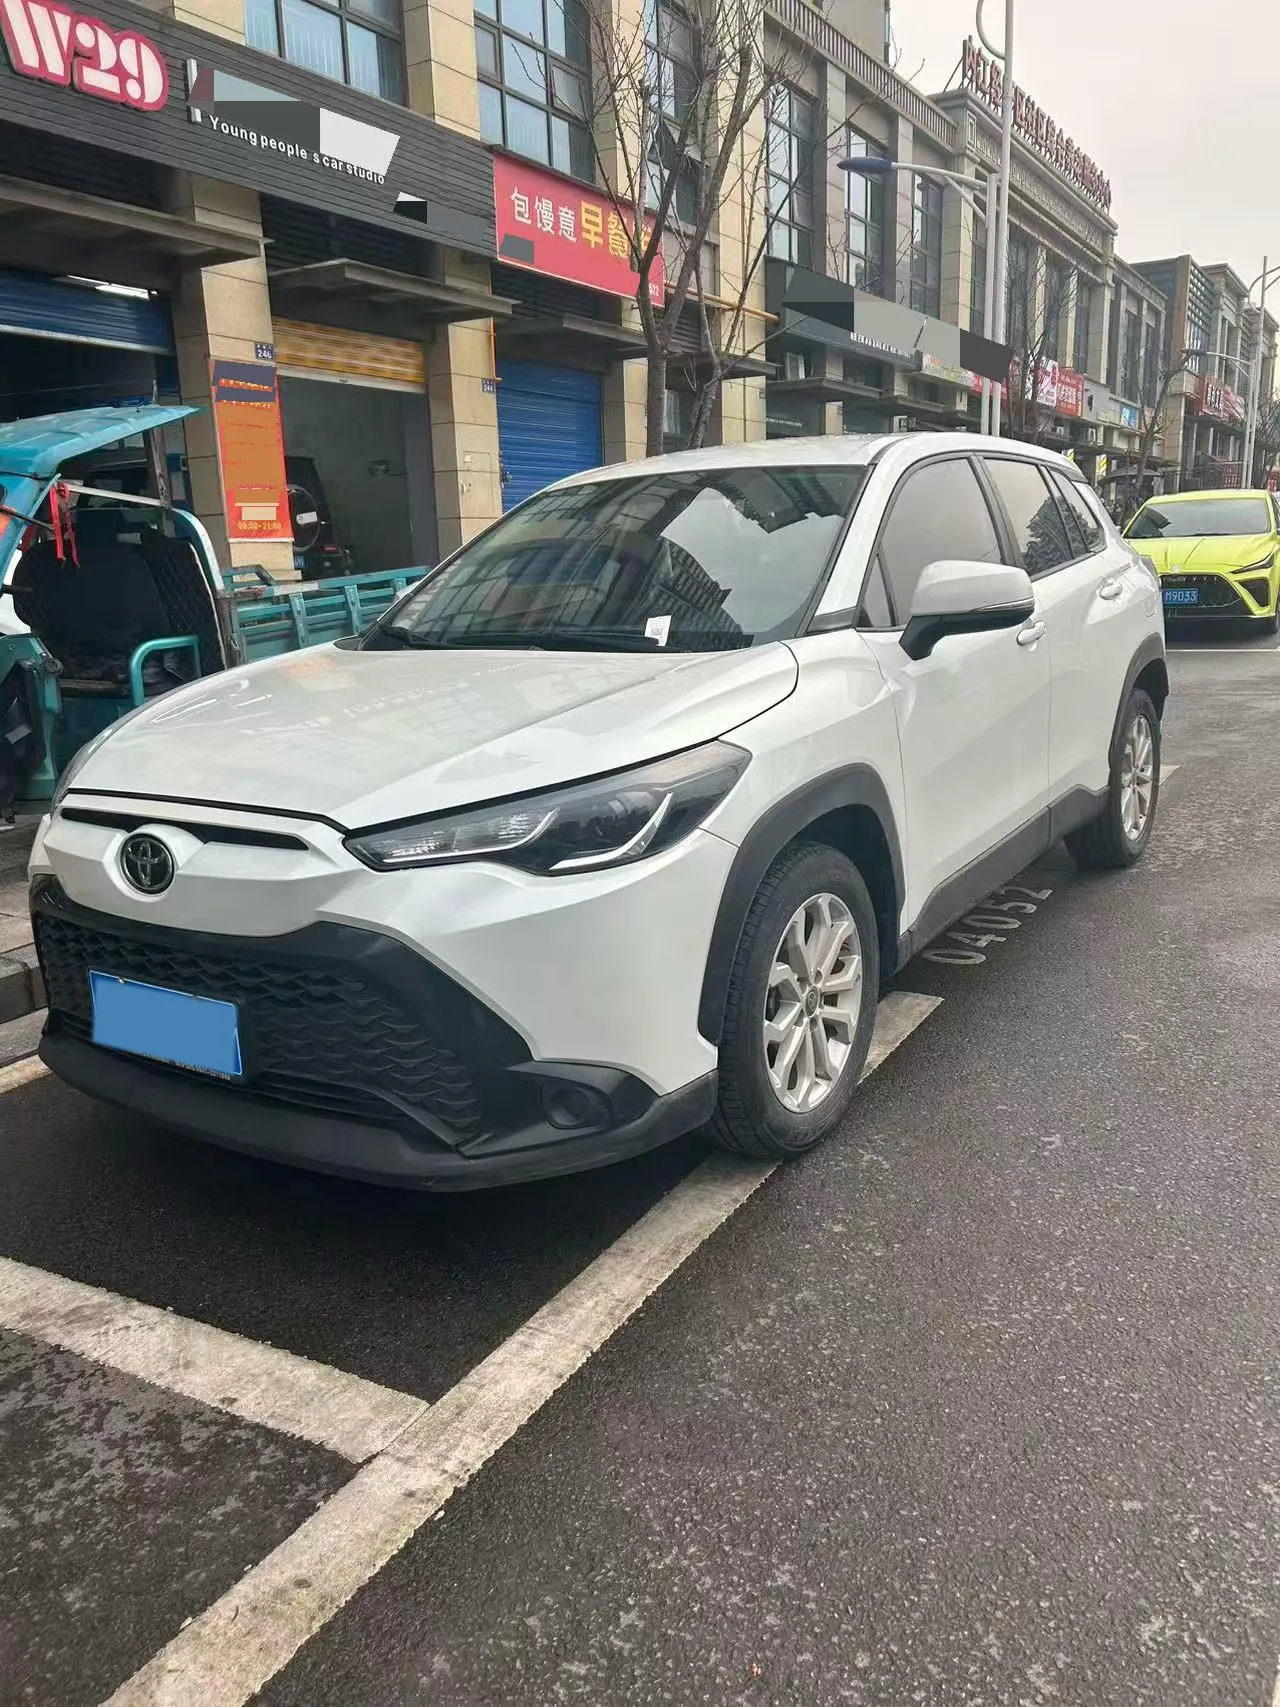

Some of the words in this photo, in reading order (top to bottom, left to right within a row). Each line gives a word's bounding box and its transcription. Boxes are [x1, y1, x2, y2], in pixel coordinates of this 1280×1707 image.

[0, 0, 167, 109] W29
[209, 114, 257, 146] Young
[260, 134, 308, 159] people
[322, 156, 344, 171] car
[1165, 590, 1197, 602] M9033
[921, 885, 1053, 965] 04052
